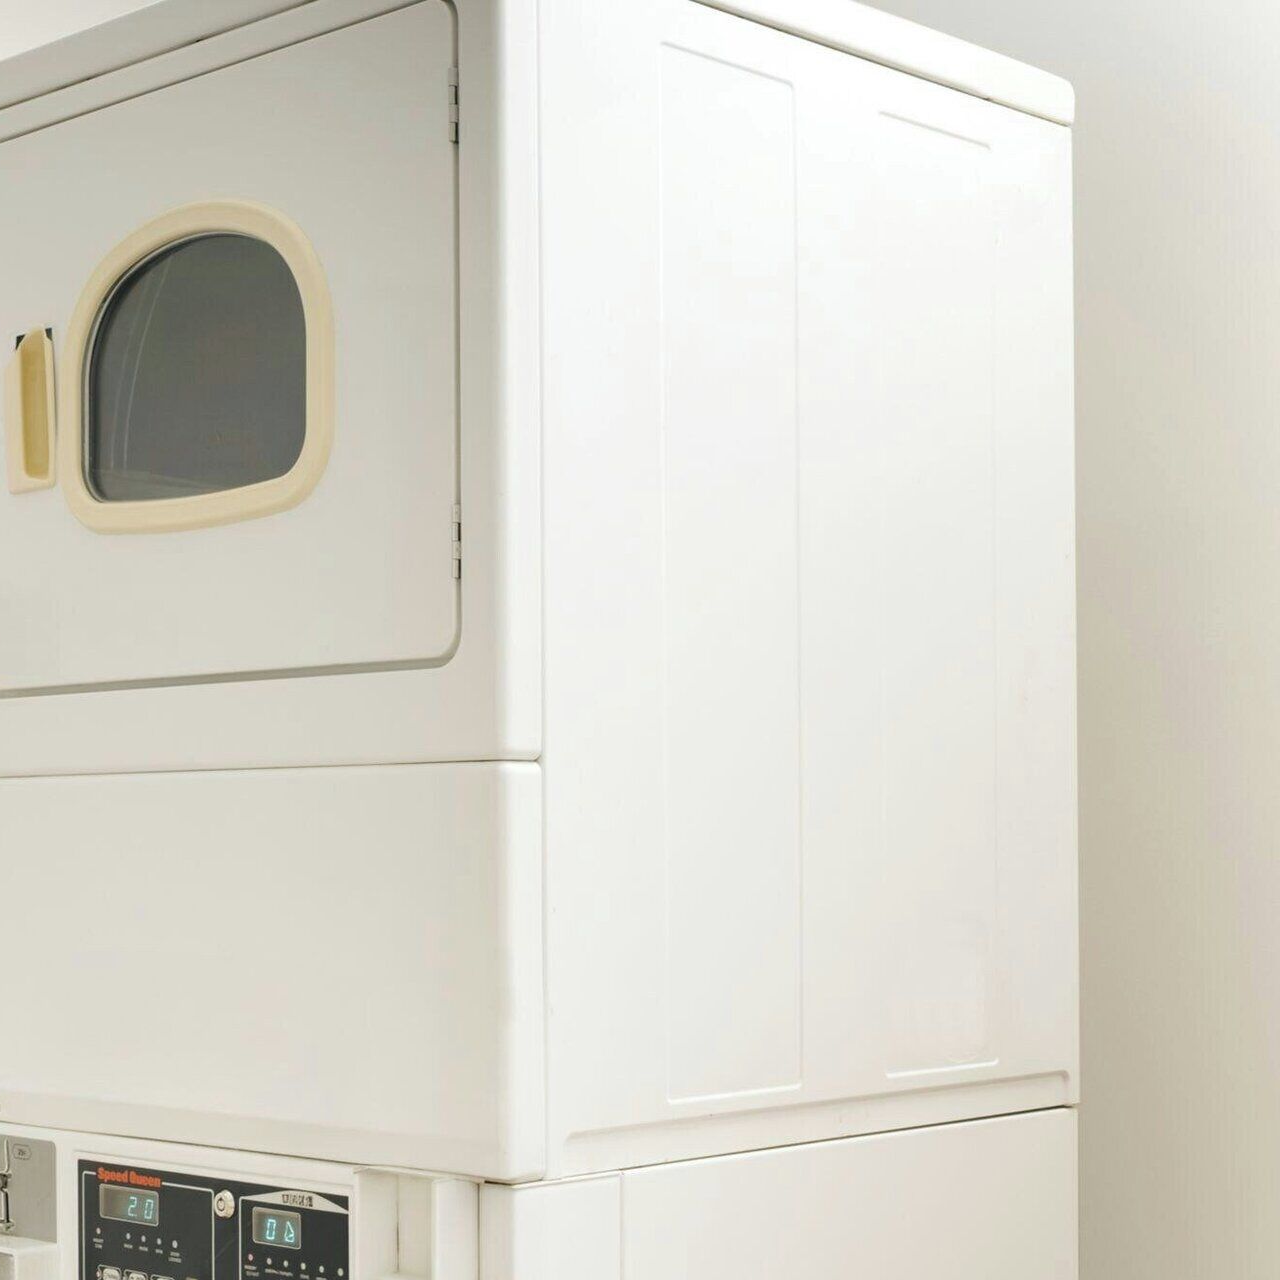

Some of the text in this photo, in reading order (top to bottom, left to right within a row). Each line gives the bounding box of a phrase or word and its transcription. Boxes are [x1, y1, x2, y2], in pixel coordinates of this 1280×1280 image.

[97, 1167, 161, 1188] Speed Queen
[127, 1196, 154, 1219] 20
